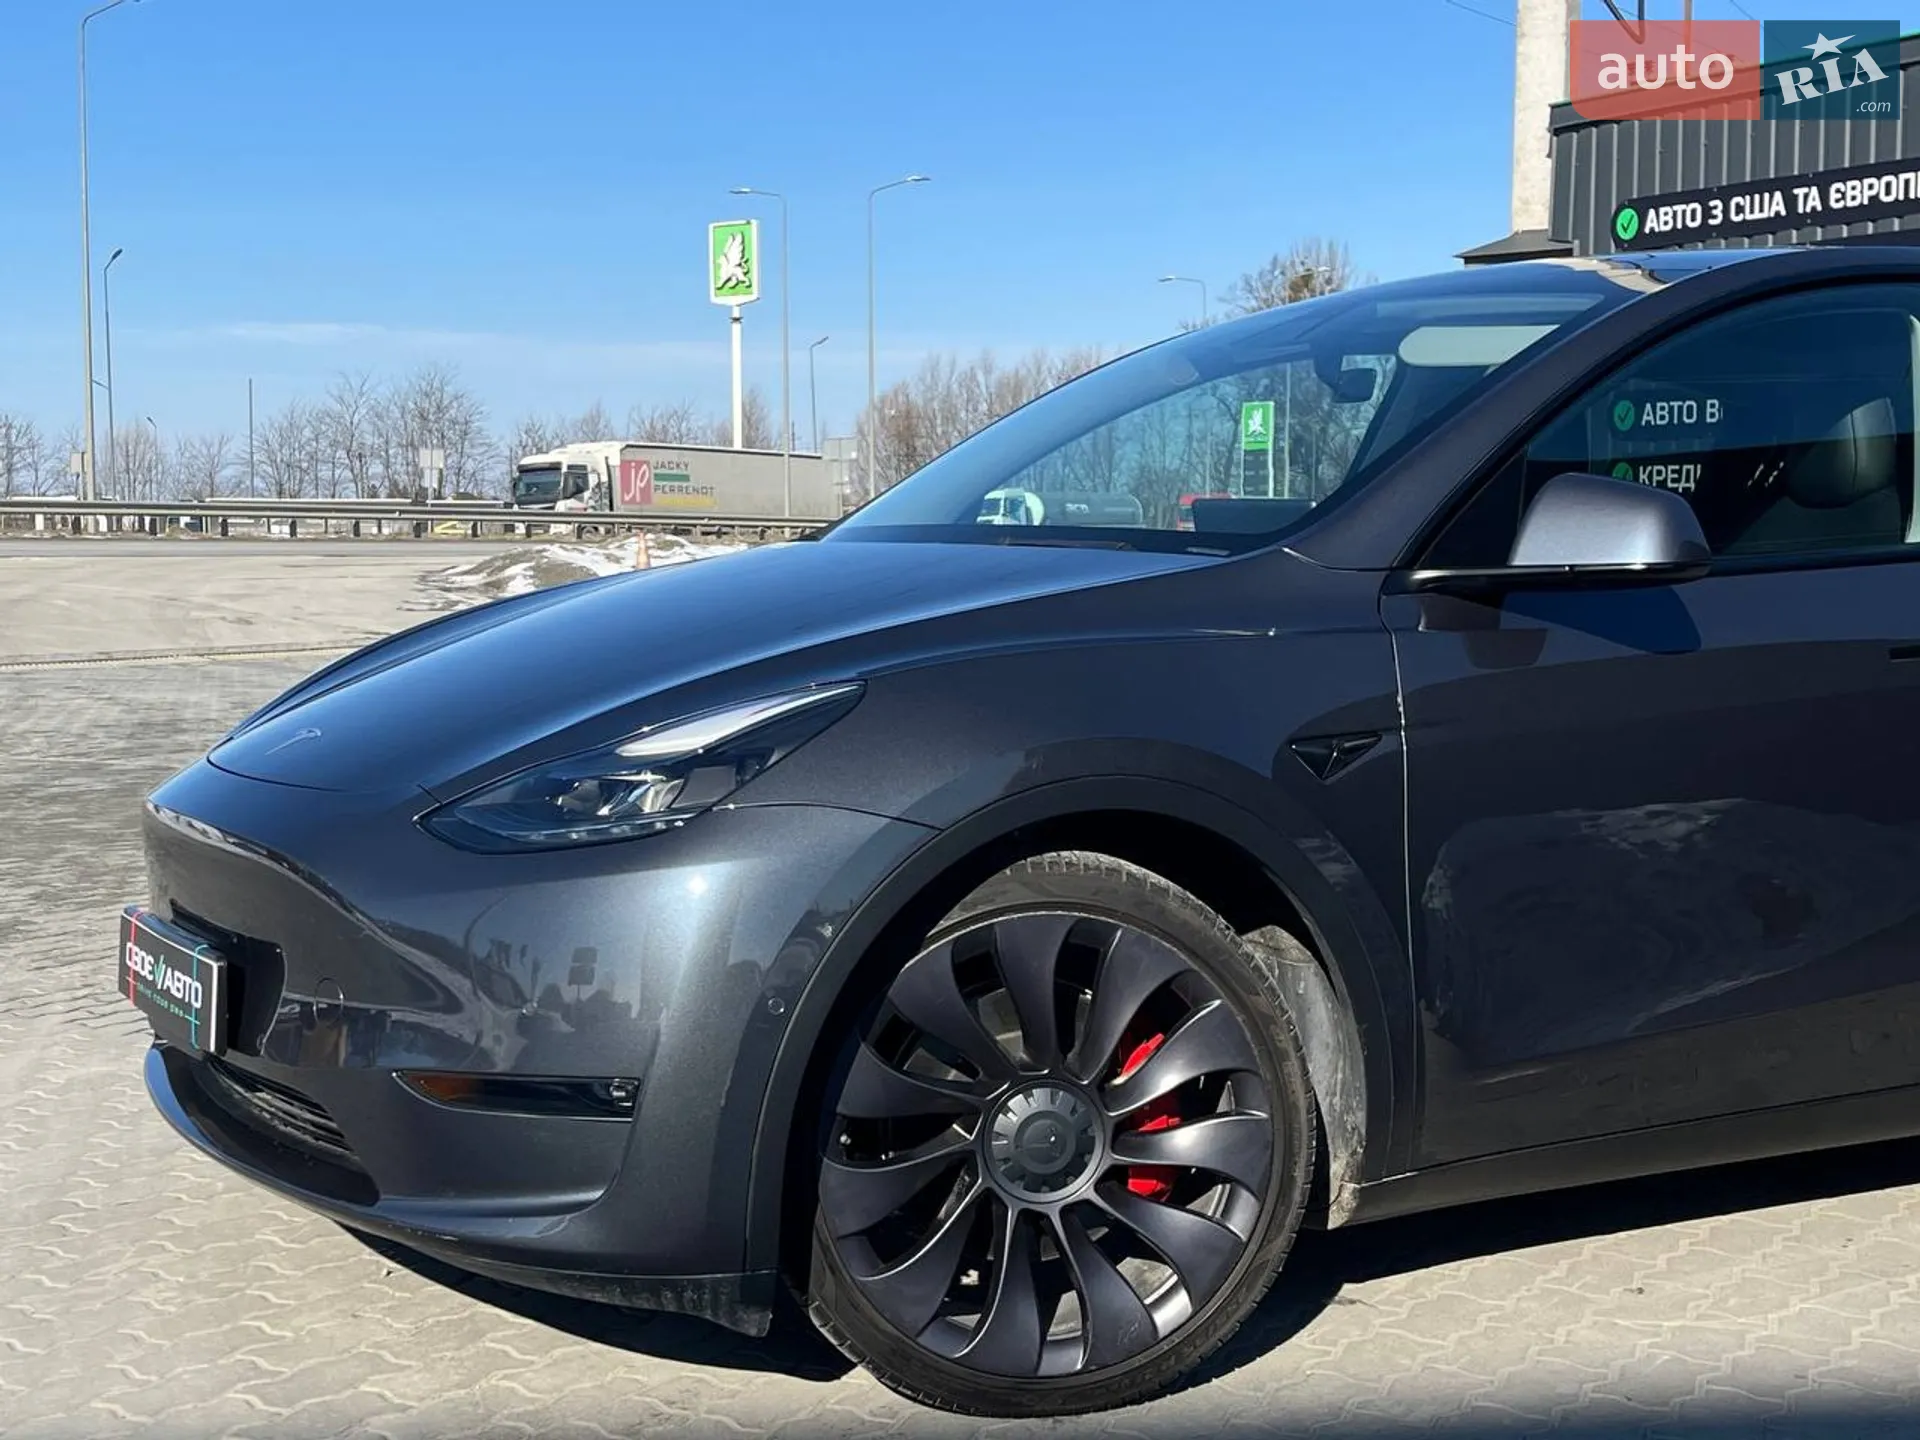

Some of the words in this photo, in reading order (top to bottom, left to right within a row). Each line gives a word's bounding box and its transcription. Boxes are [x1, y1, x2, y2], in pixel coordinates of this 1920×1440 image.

[1644, 202, 1703, 235] АВТО
[1729, 190, 1787, 223] США
[1792, 185, 1823, 214] ТА
[1641, 400, 1698, 427] АВТО
[1705, 398, 1724, 424] В
[653, 460, 690, 471] JACKY
